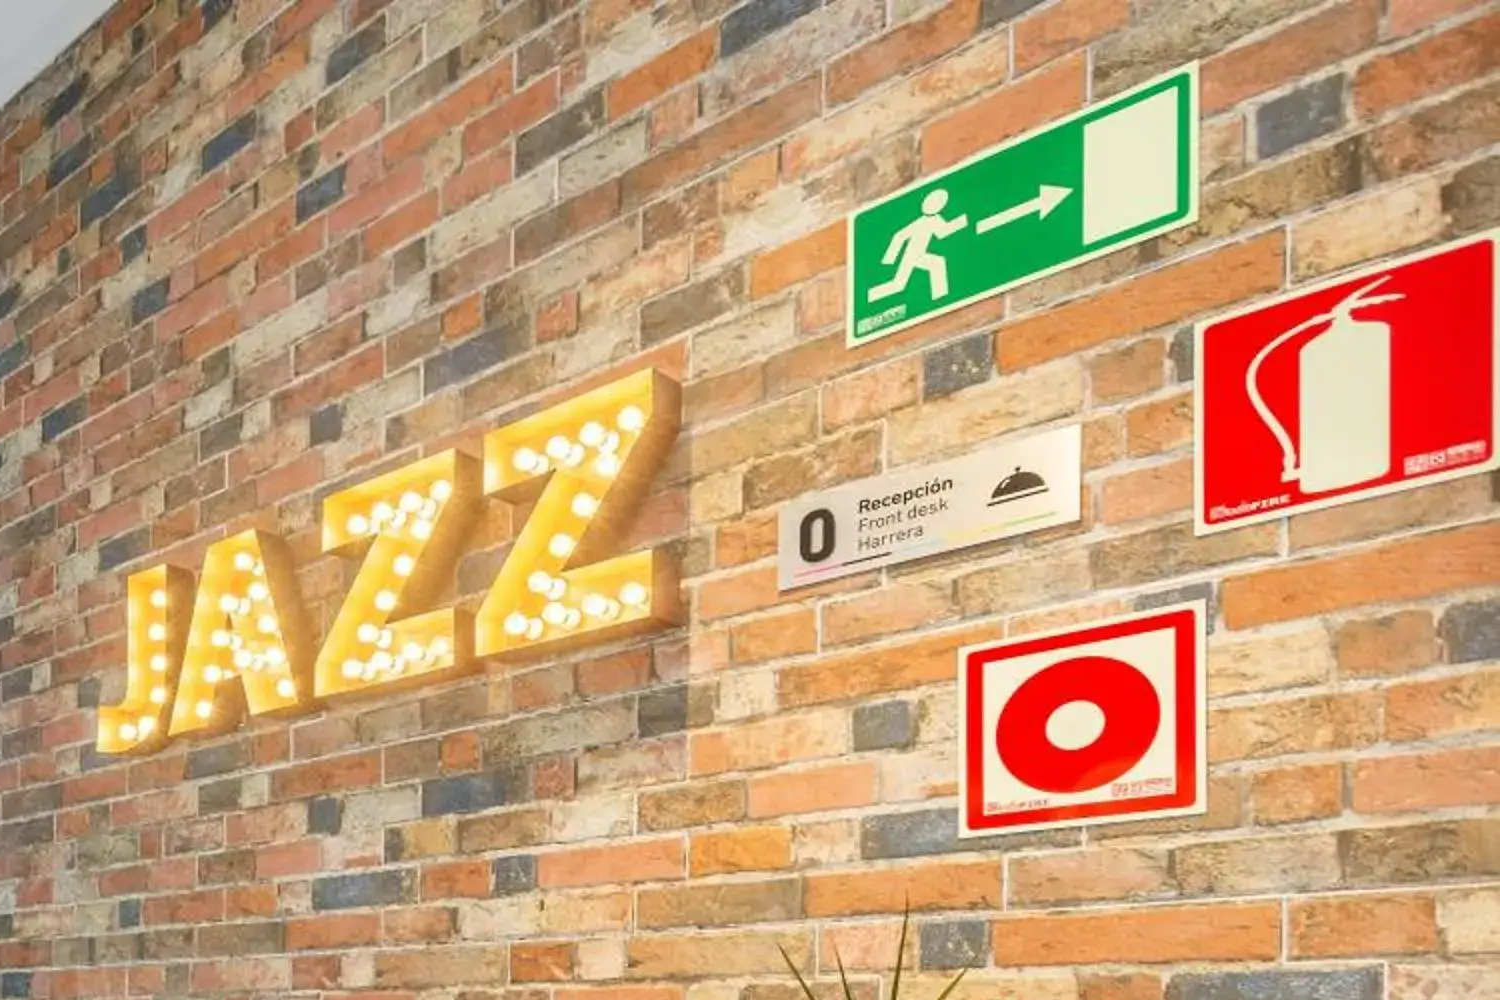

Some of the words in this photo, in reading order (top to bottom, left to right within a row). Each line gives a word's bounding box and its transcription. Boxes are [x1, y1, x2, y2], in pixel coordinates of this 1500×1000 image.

[858, 477, 953, 513] Recepción
[858, 509, 902, 532] Front
[907, 497, 949, 519] desk
[799, 508, 837, 563] 0
[858, 525, 924, 551] Harrera
[97, 367, 681, 754] JAZZ
